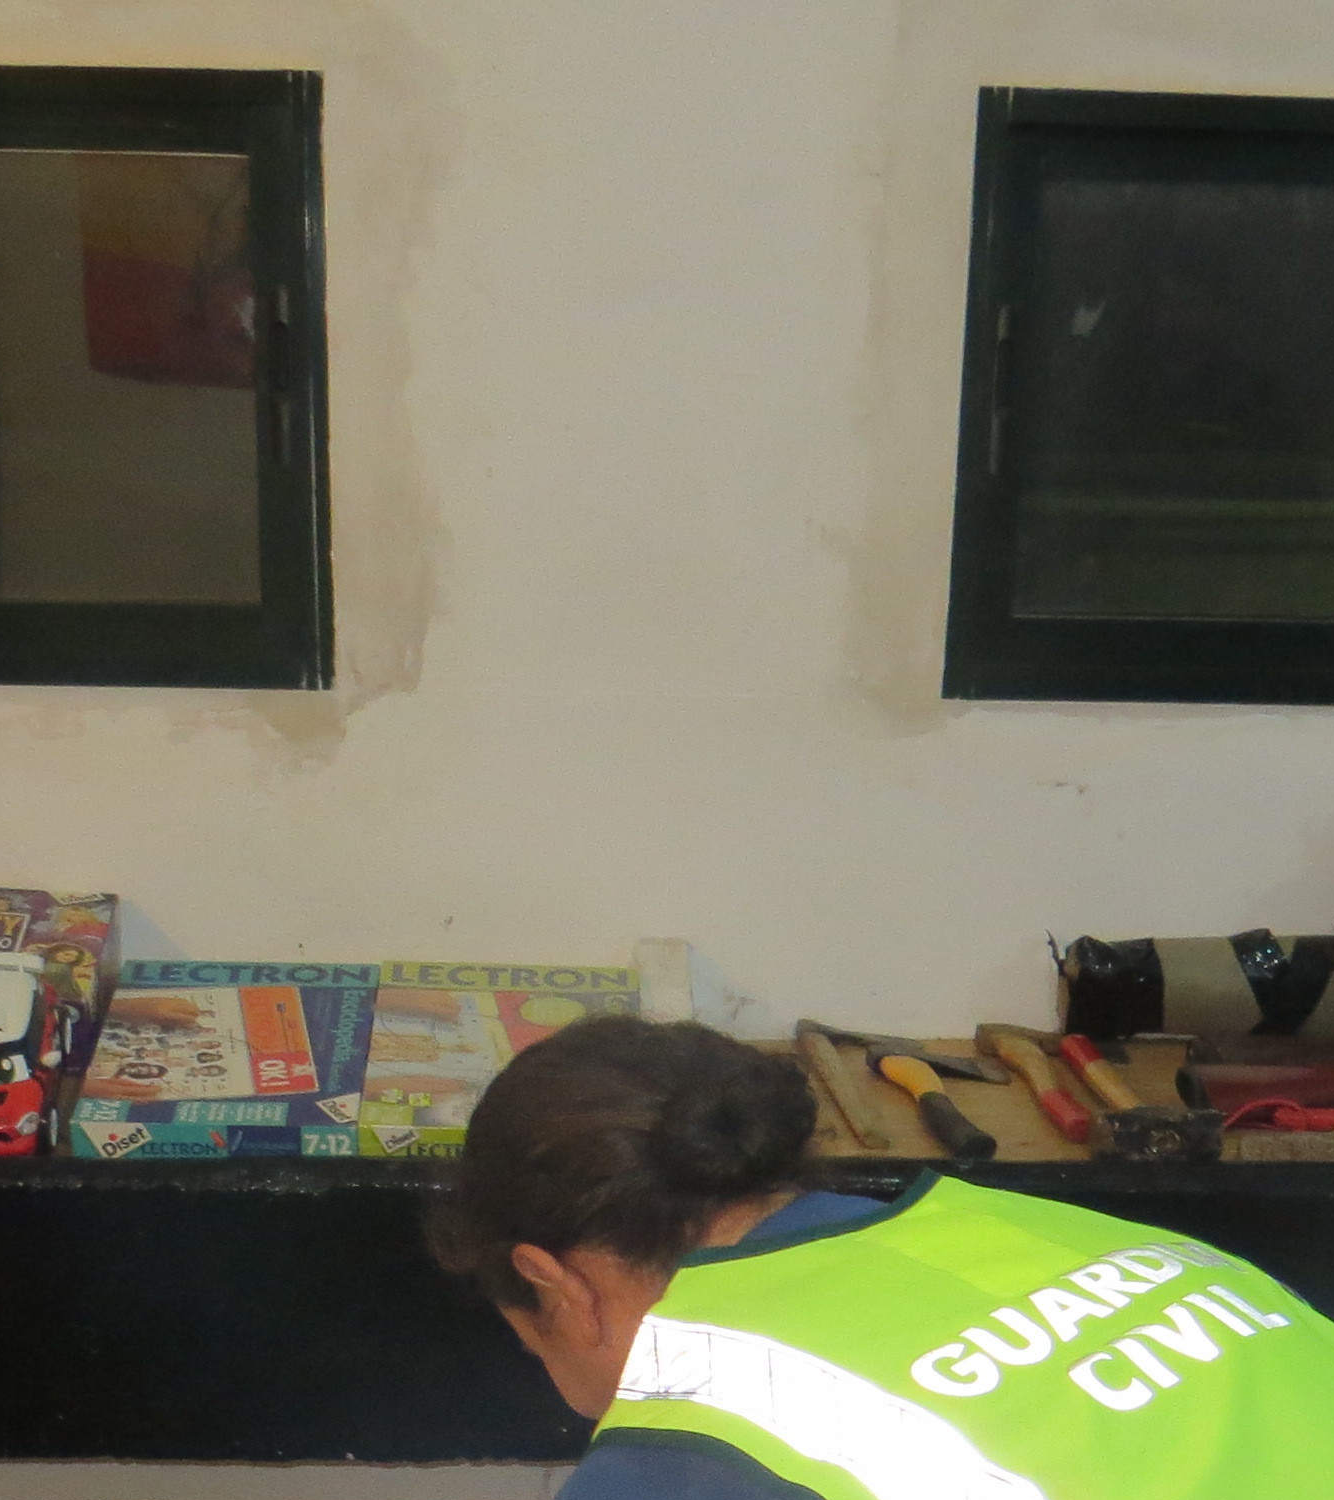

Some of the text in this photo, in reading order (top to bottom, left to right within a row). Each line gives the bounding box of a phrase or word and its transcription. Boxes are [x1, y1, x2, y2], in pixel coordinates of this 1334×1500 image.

[131, 963, 373, 985] LECTRON
[391, 963, 630, 987] LECTRON
[258, 1059, 290, 1087] OK!
[102, 1127, 146, 1156] Diset
[1067, 1284, 1291, 1411] CIVIL
